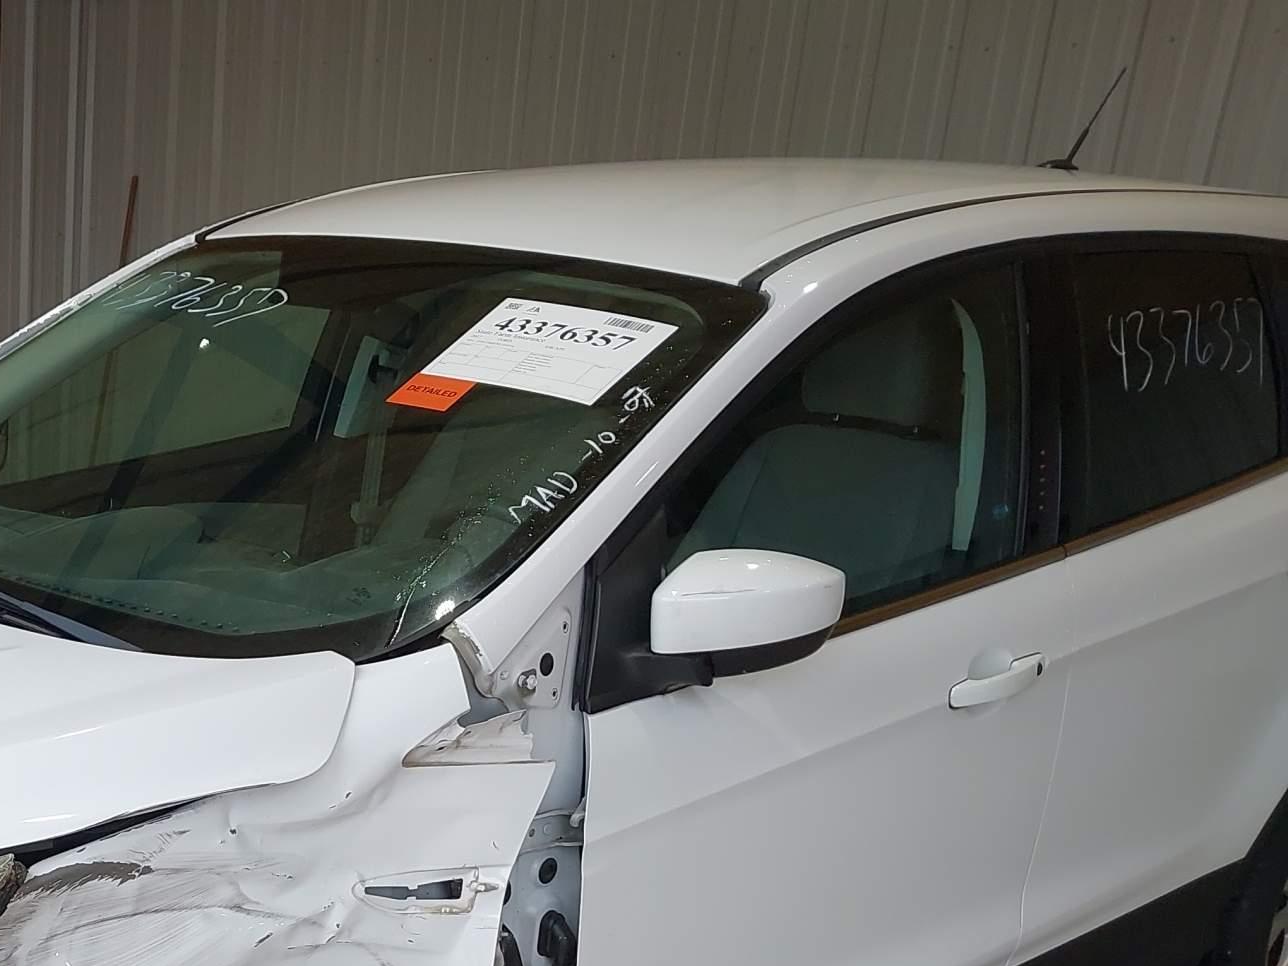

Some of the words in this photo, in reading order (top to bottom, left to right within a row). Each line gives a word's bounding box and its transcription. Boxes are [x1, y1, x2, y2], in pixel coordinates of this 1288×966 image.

[494, 316, 637, 351] 43376357
[406, 383, 458, 399] DETAILED
[508, 471, 578, 525] MAD
